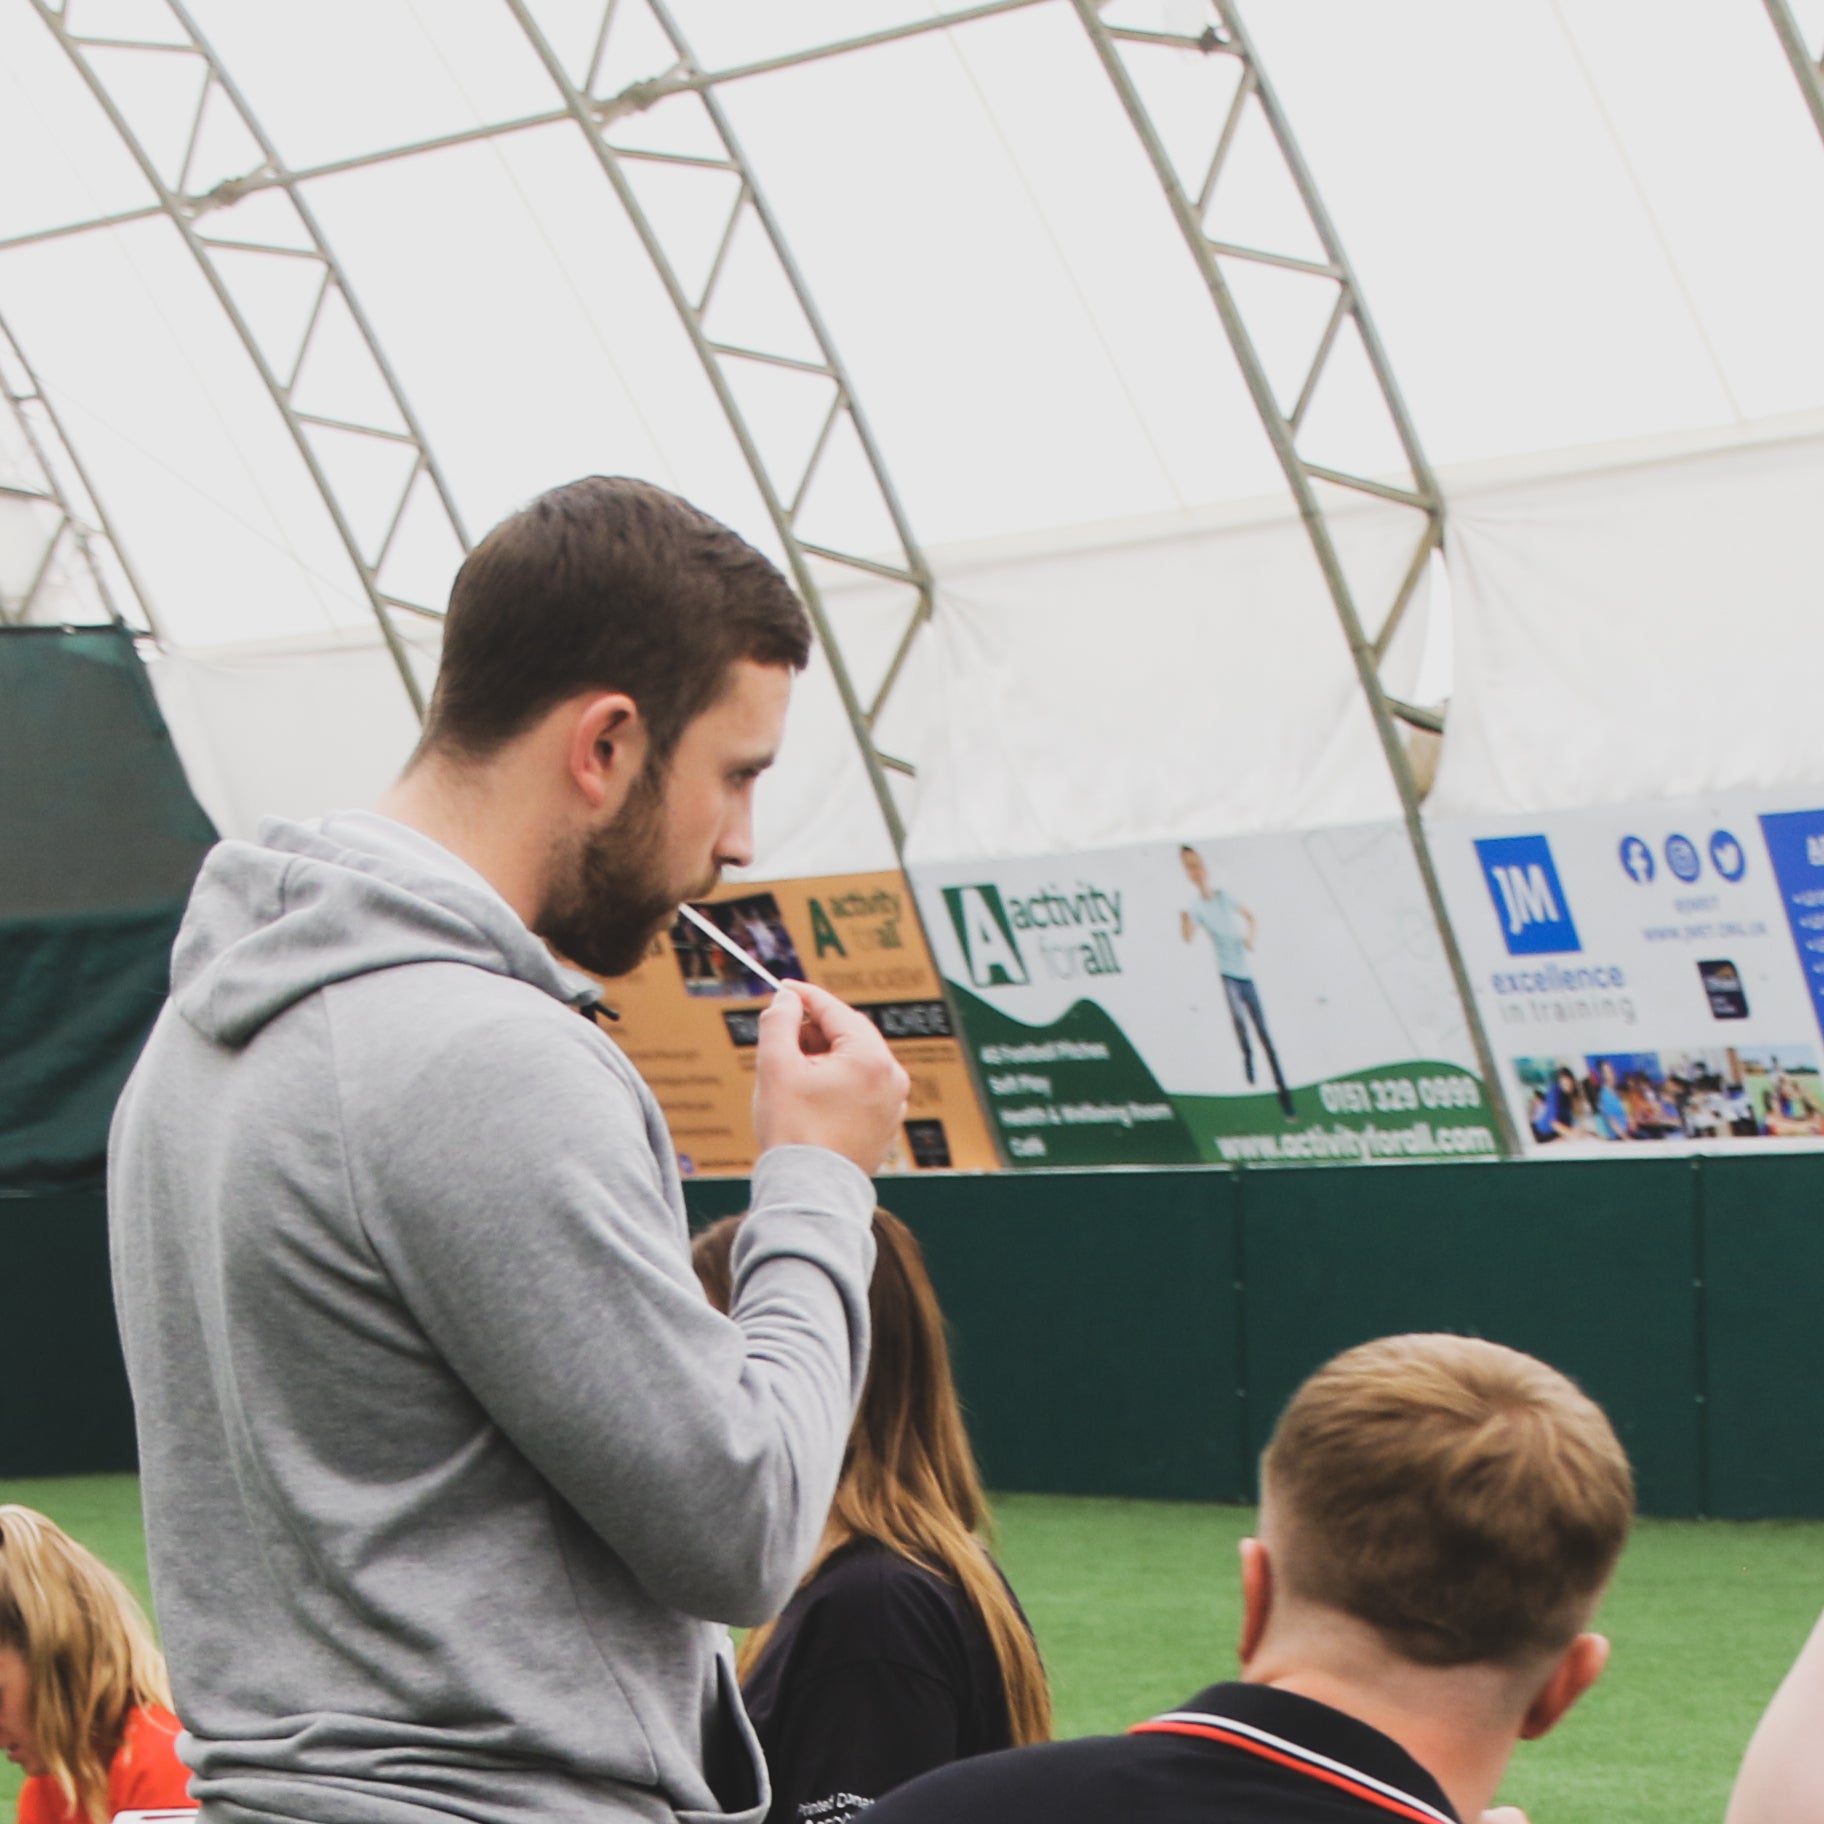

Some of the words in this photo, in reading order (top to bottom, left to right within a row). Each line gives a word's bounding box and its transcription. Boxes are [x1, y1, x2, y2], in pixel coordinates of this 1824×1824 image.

[1009, 883, 1122, 934] activity
[1492, 864, 1560, 936] JM
[1492, 962, 1625, 996] excellence
[1320, 1081, 1372, 1114] 0151
[1215, 1121, 1497, 1161] www.activityforall.com
